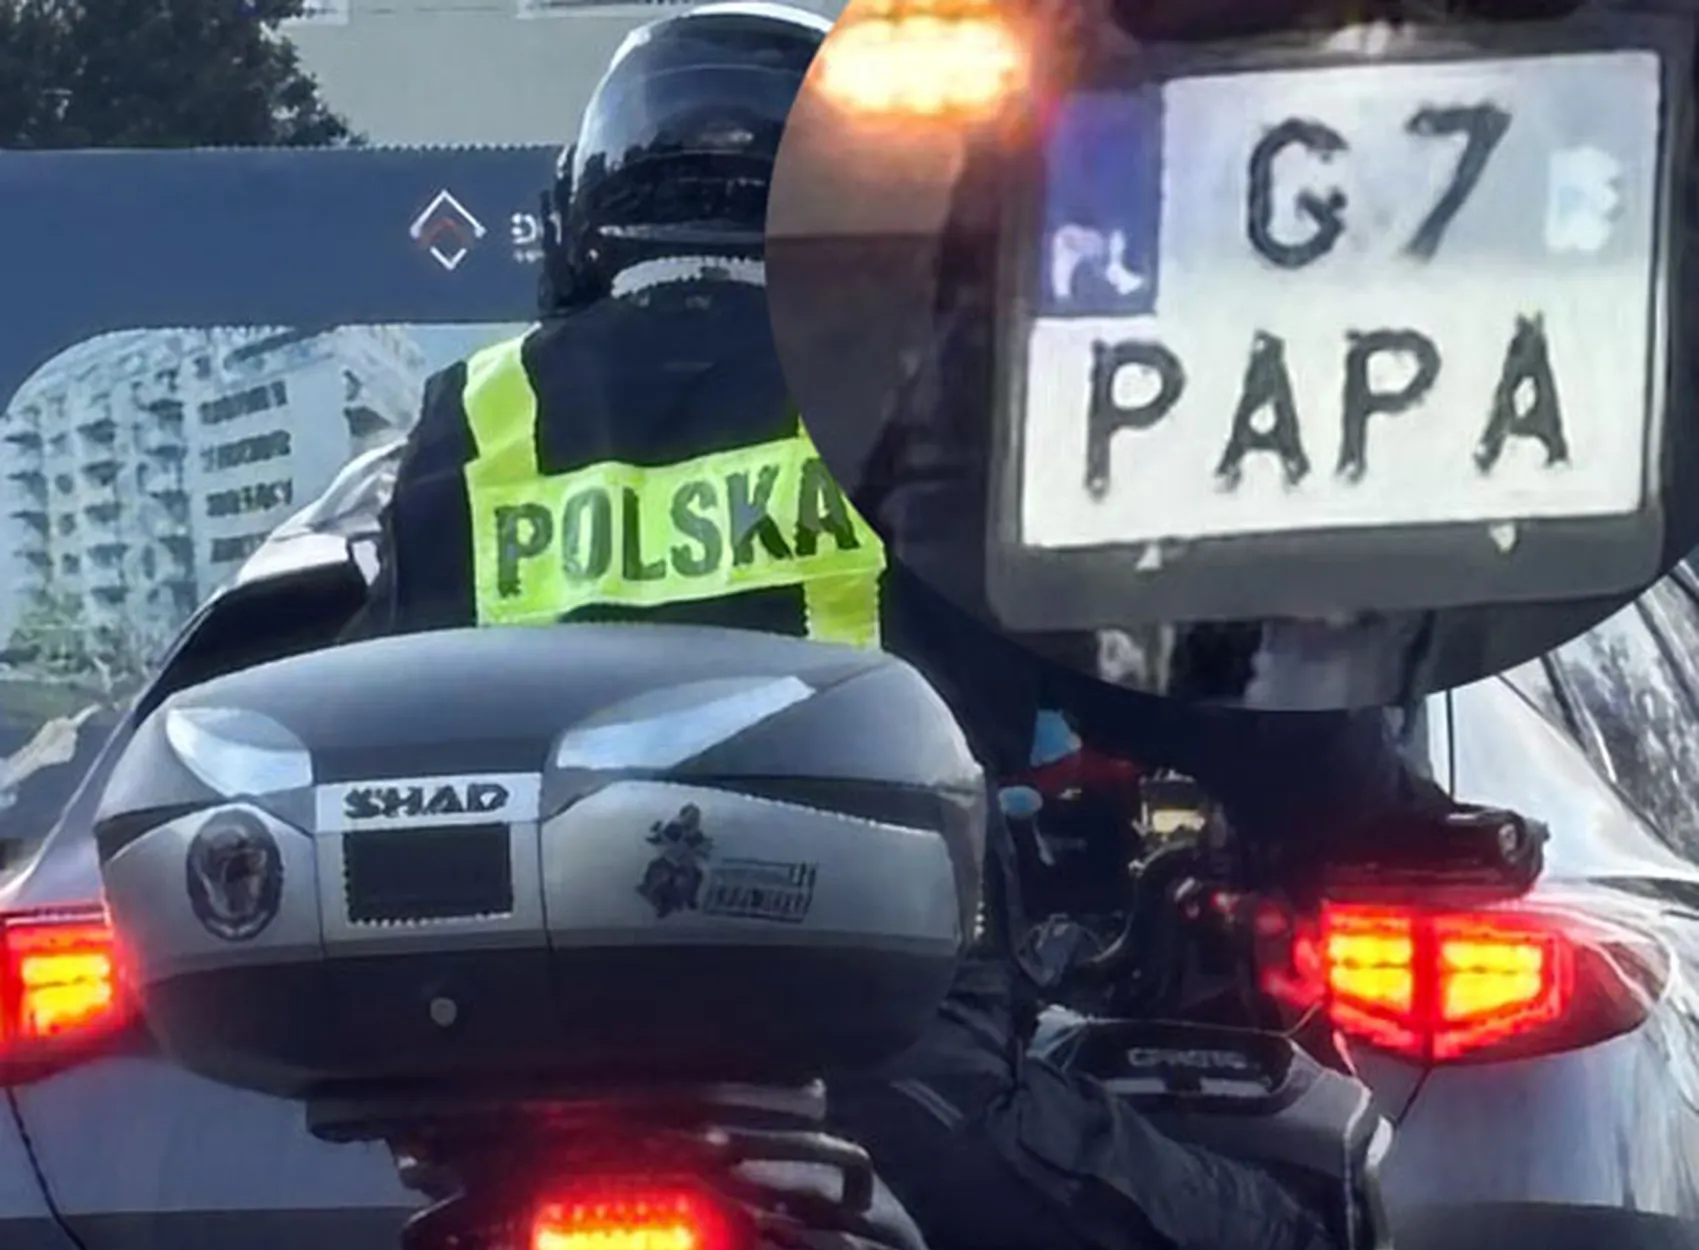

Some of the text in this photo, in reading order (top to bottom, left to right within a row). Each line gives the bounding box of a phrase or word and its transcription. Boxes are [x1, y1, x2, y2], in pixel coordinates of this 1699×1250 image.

[1246, 99, 1513, 269] G7
[1050, 222, 1144, 300] PL
[1085, 311, 1571, 504] PAPA
[494, 456, 860, 598] POLSKA
[344, 782, 509, 819] SHAD
